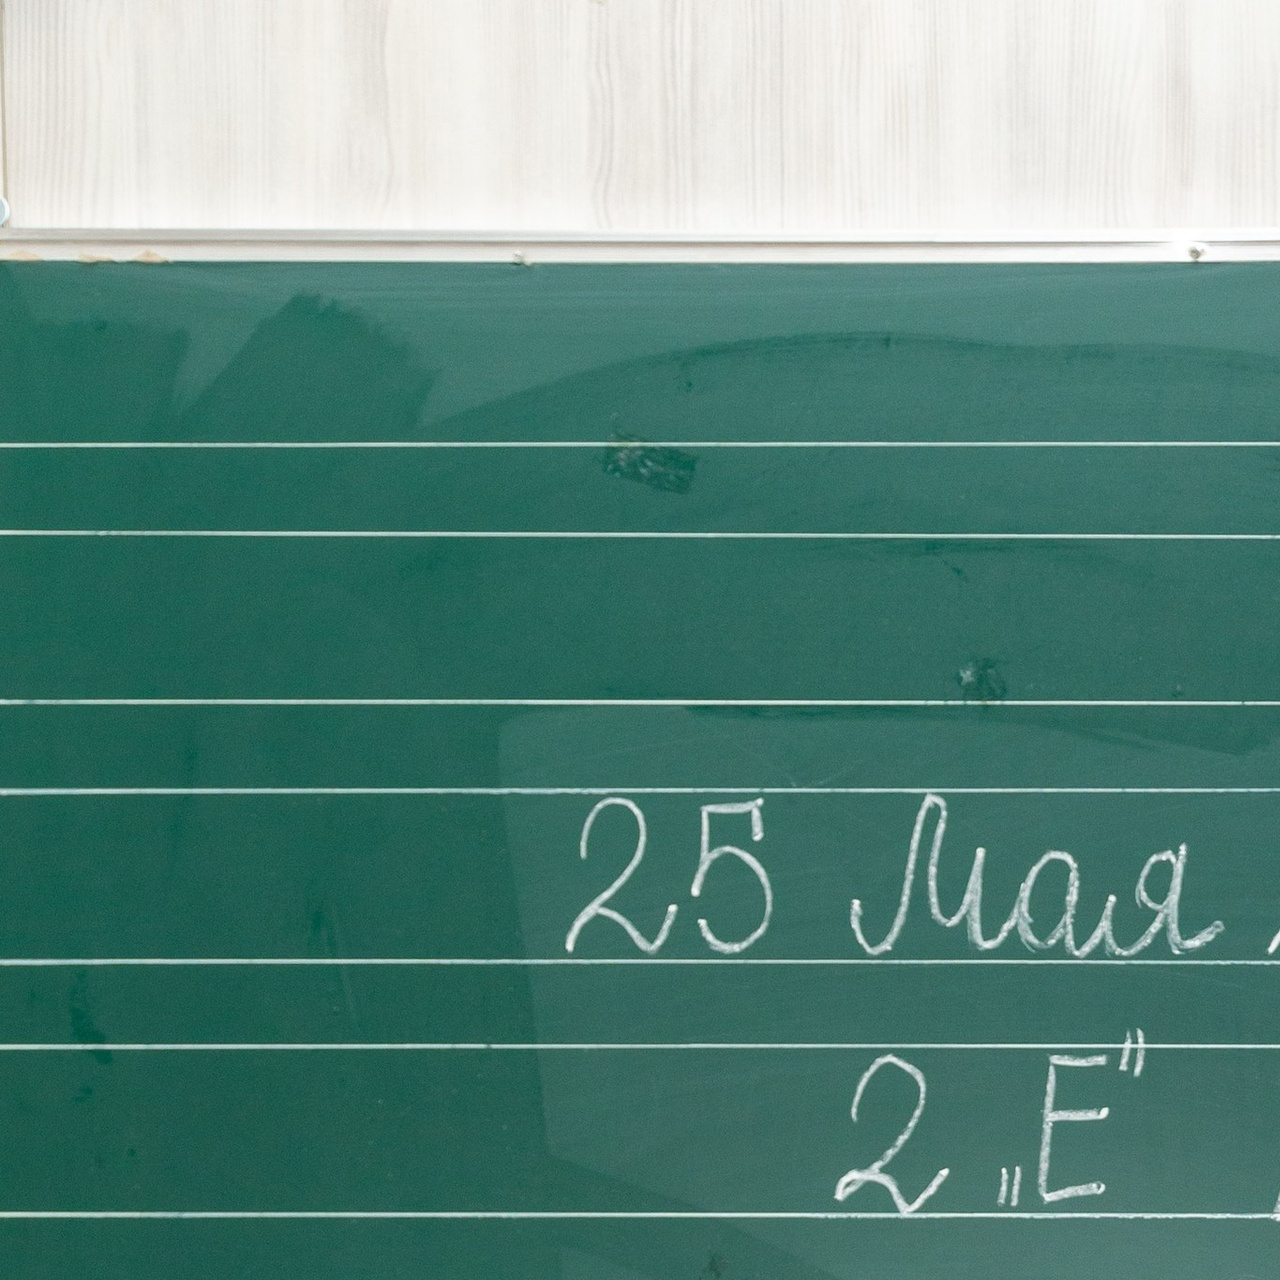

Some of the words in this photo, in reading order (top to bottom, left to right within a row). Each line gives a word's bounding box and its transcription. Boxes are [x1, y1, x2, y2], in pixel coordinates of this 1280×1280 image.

[565, 796, 773, 955] 25
[850, 793, 1225, 957] Мая
[833, 1053, 950, 1215] 2
